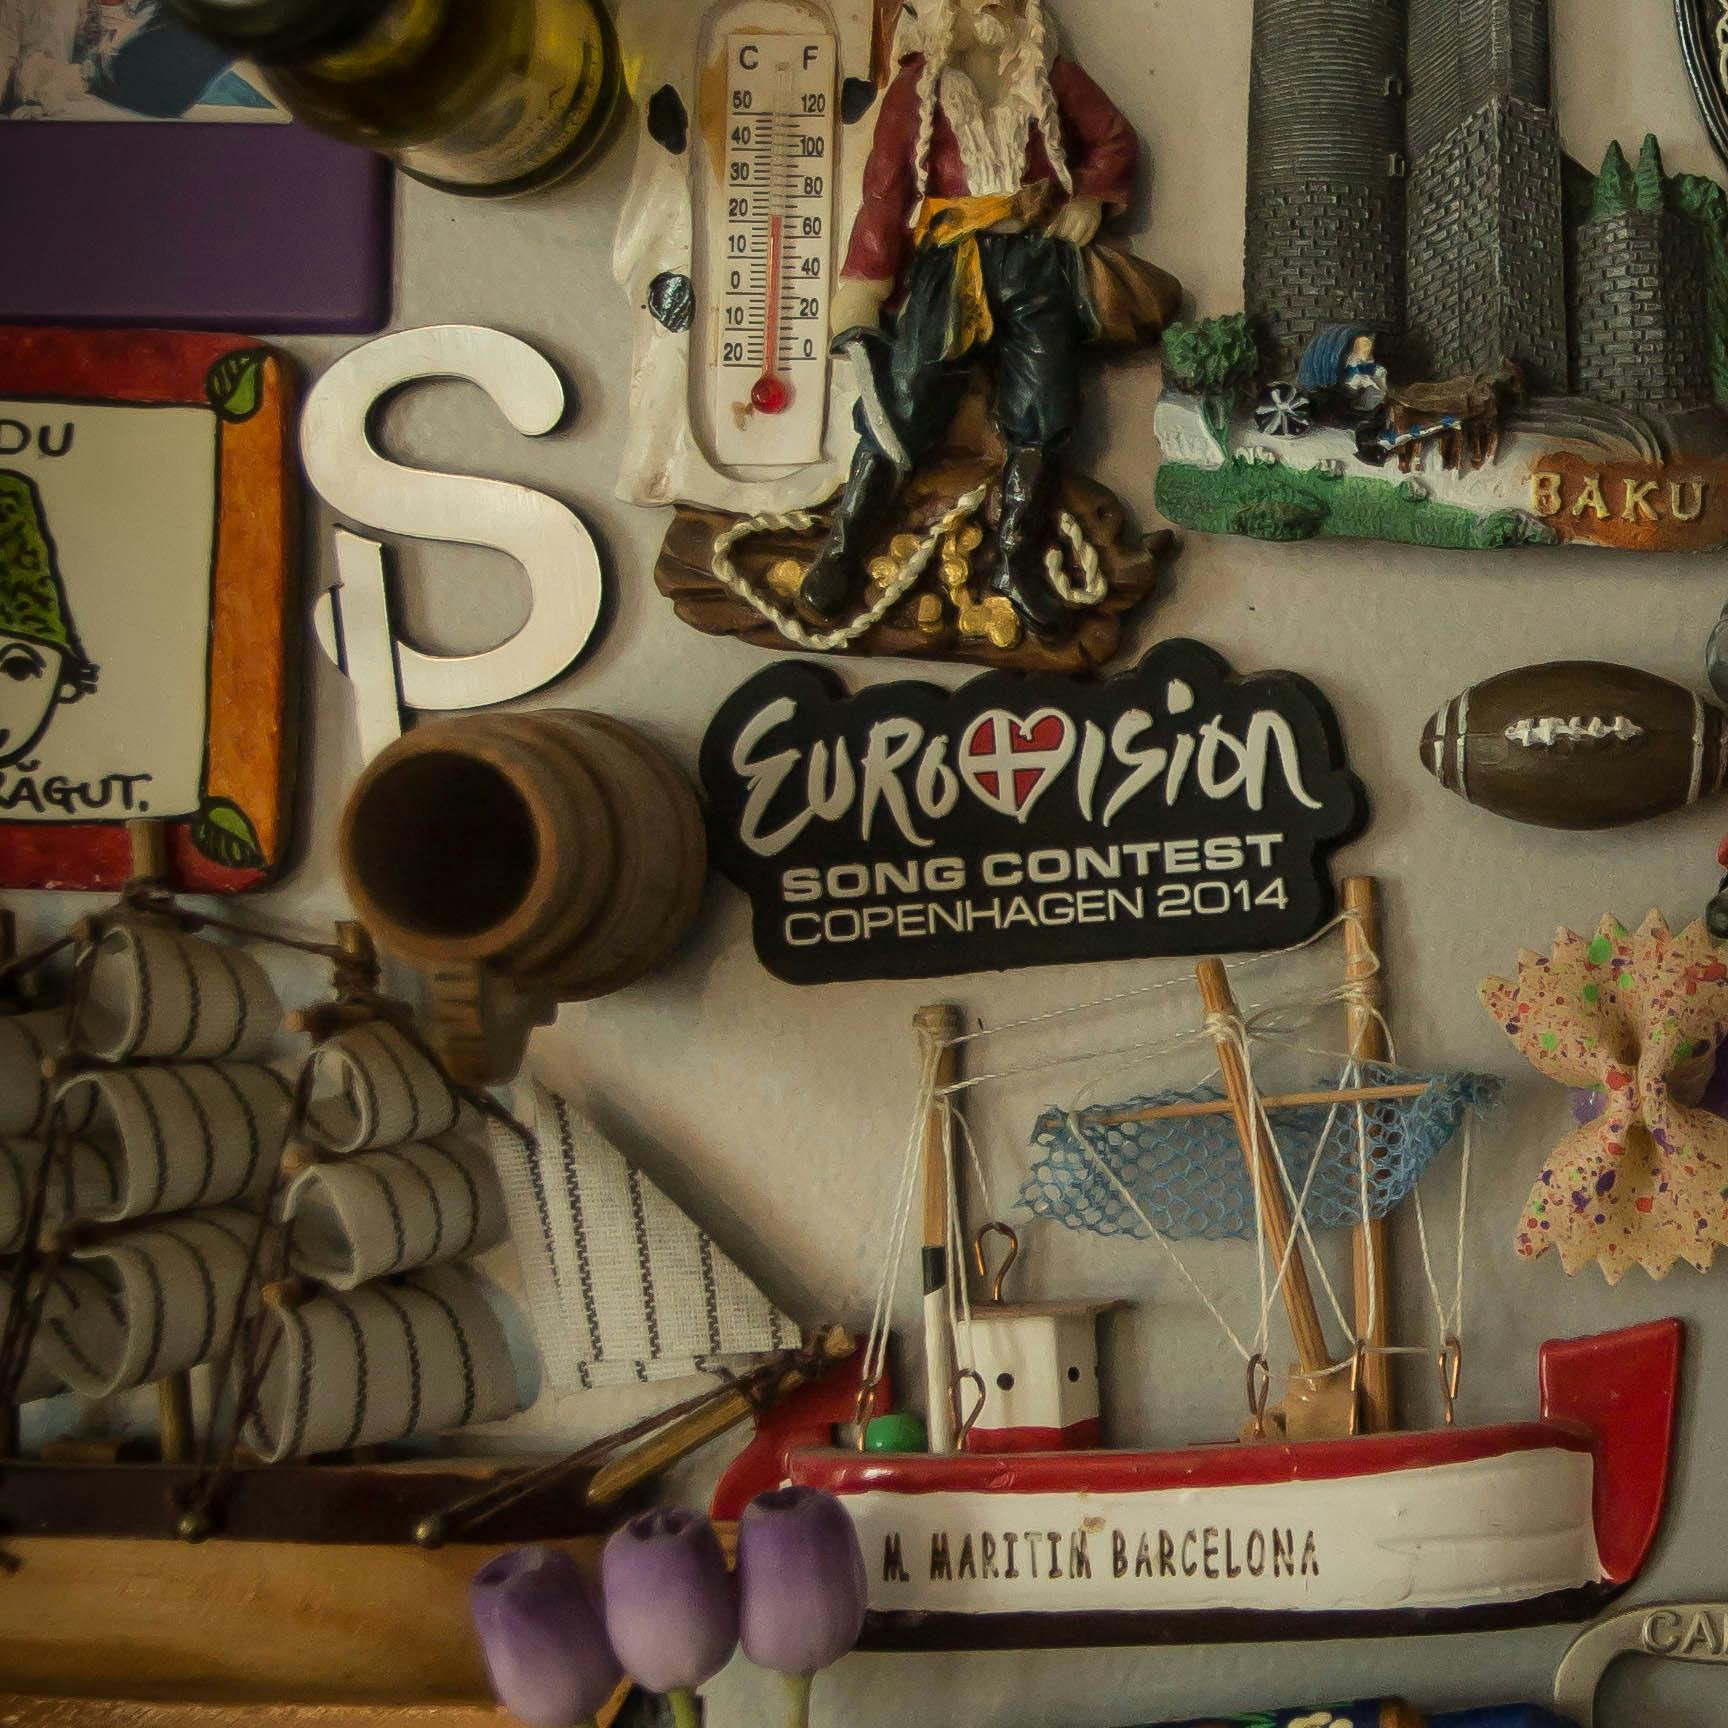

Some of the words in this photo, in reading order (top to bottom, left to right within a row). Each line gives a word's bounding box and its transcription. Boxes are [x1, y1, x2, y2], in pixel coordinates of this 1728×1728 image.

[739, 45, 760, 71] C
[802, 45, 820, 72] F
[731, 90, 753, 110] 50
[800, 92, 826, 113] 120
[730, 126, 752, 146] 40
[799, 135, 825, 157] 100
[729, 163, 751, 182] 30
[804, 176, 824, 196] 80
[728, 198, 749, 218] 20
[802, 216, 822, 236] 60
[727, 234, 747, 254] 10
[801, 257, 821, 277] 40
[730, 271, 741, 290] 0
[799, 298, 820, 318] 20
[723, 343, 744, 362] 20
[726, 307, 745, 326] 10
[803, 338, 814, 358] 0
[1531, 471, 1709, 522] BAKU
[782, 855, 967, 903] SONG
[982, 832, 1286, 889] CONTEST
[784, 886, 1145, 949] COPENHAGEN
[1157, 876, 1290, 920] 2014
[929, 1528, 1093, 1581] MARITIM
[1111, 1526, 1320, 1580] BARCELONA
